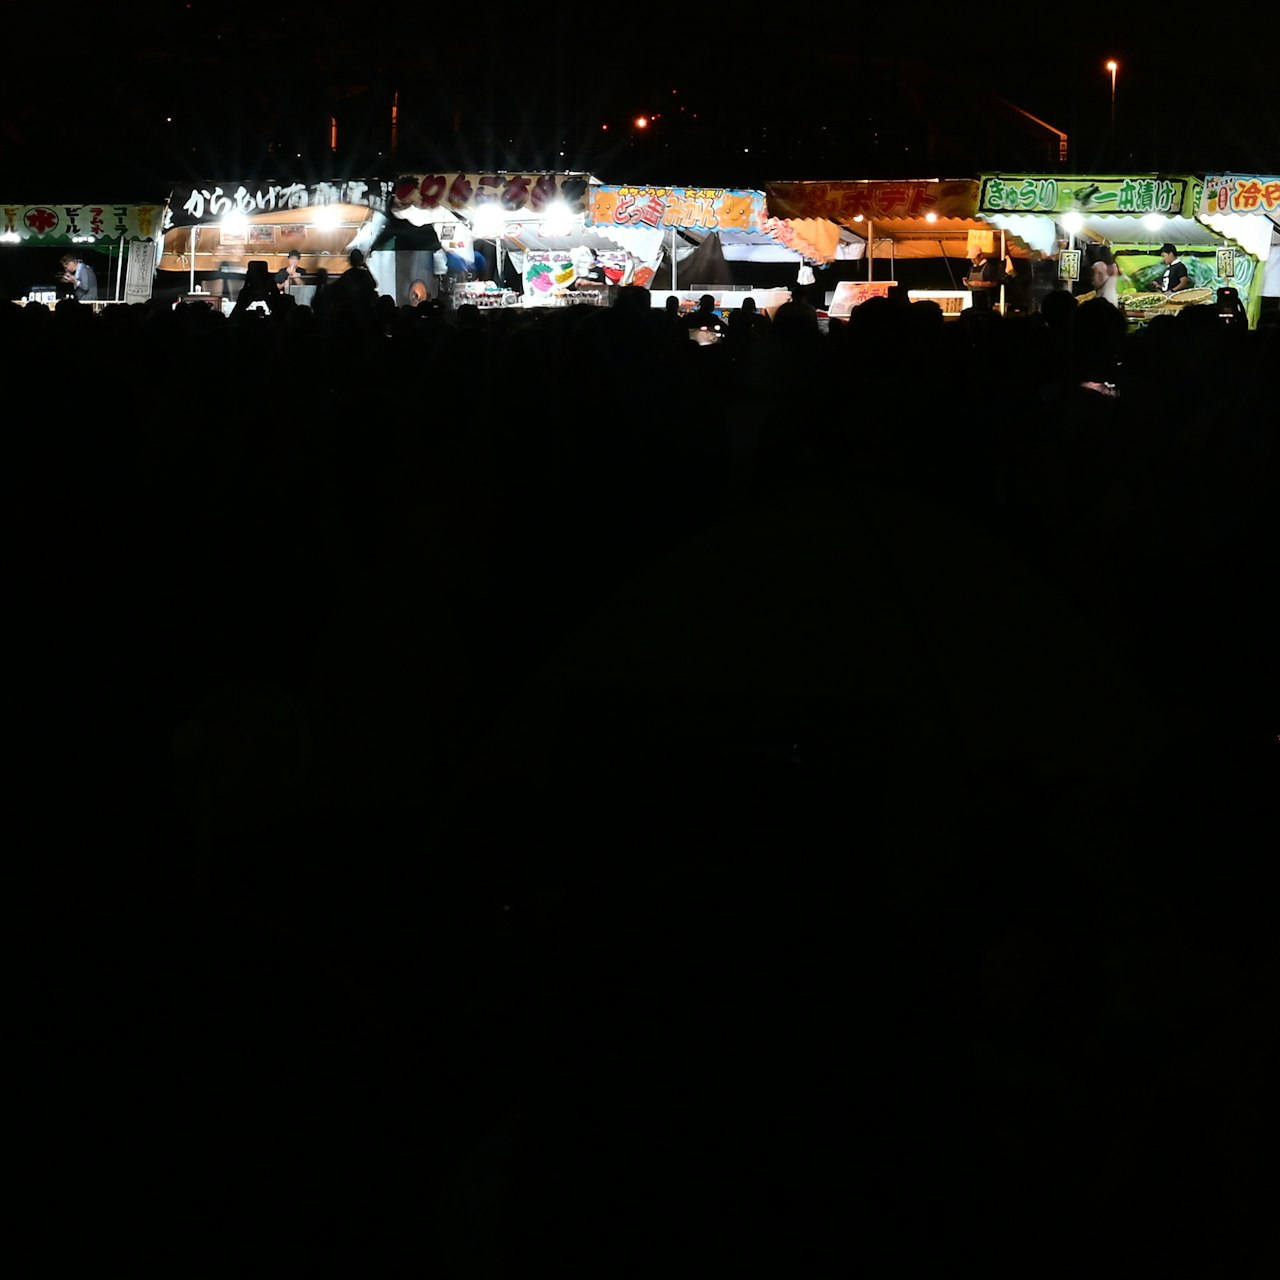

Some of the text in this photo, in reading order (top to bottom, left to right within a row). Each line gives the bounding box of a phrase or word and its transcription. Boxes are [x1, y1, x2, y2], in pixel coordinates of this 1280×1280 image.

[986, 179, 1058, 209] きゅうり
[1093, 179, 1175, 212] 一本漬け
[65, 207, 82, 234] ビール
[89, 207, 105, 235] ラムネ
[113, 207, 129, 236] コーラ
